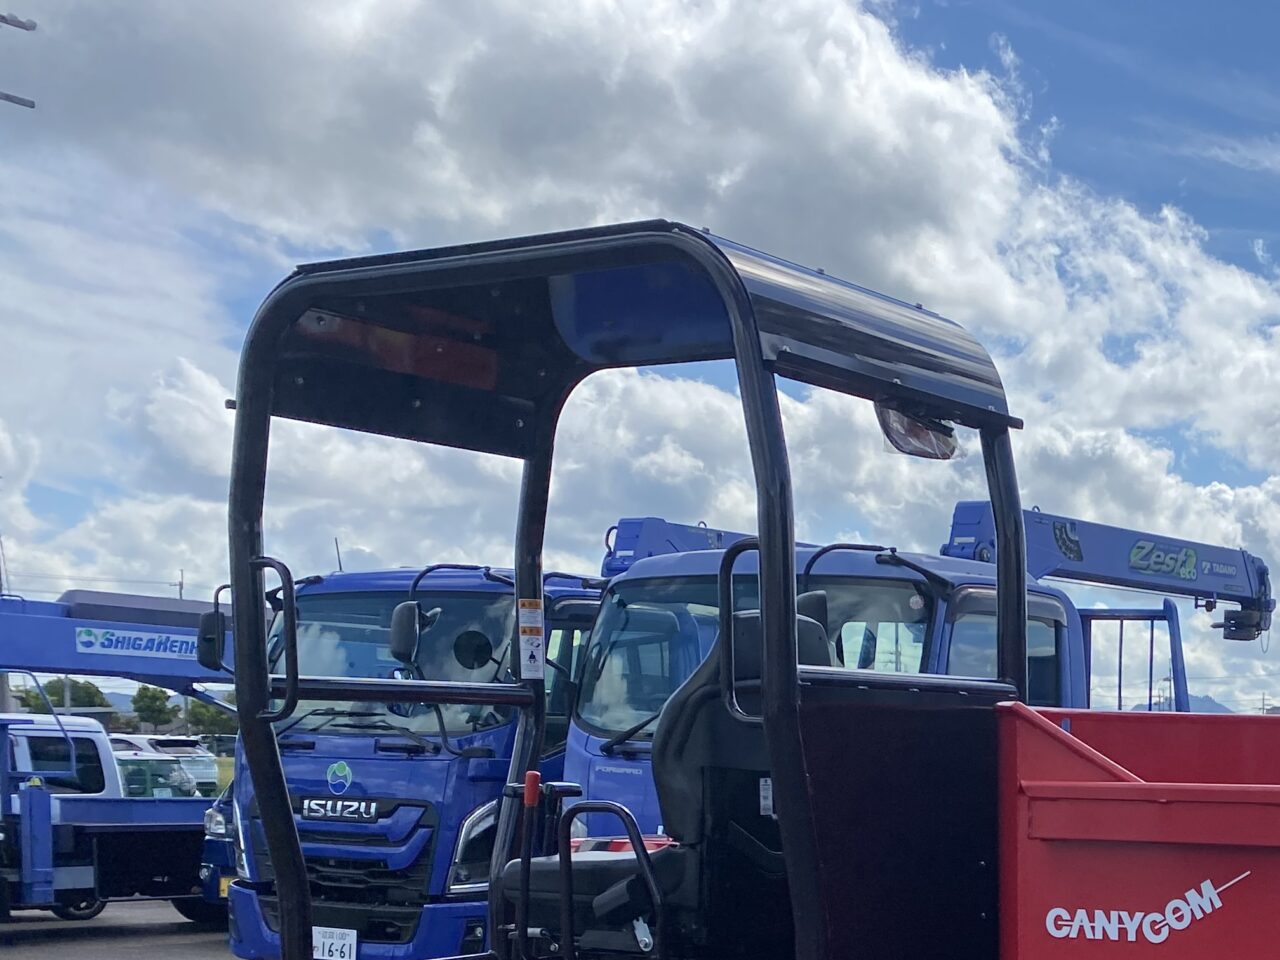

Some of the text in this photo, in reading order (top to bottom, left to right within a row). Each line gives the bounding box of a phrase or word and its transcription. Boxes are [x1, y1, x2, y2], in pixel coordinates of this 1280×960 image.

[1129, 540, 1187, 576] Zest
[1180, 566, 1197, 580] eco
[1212, 562, 1237, 576] TADANO
[303, 799, 376, 819] ISUZU
[1046, 879, 1223, 944] CANYCOM
[321, 941, 352, 960] 16-61
